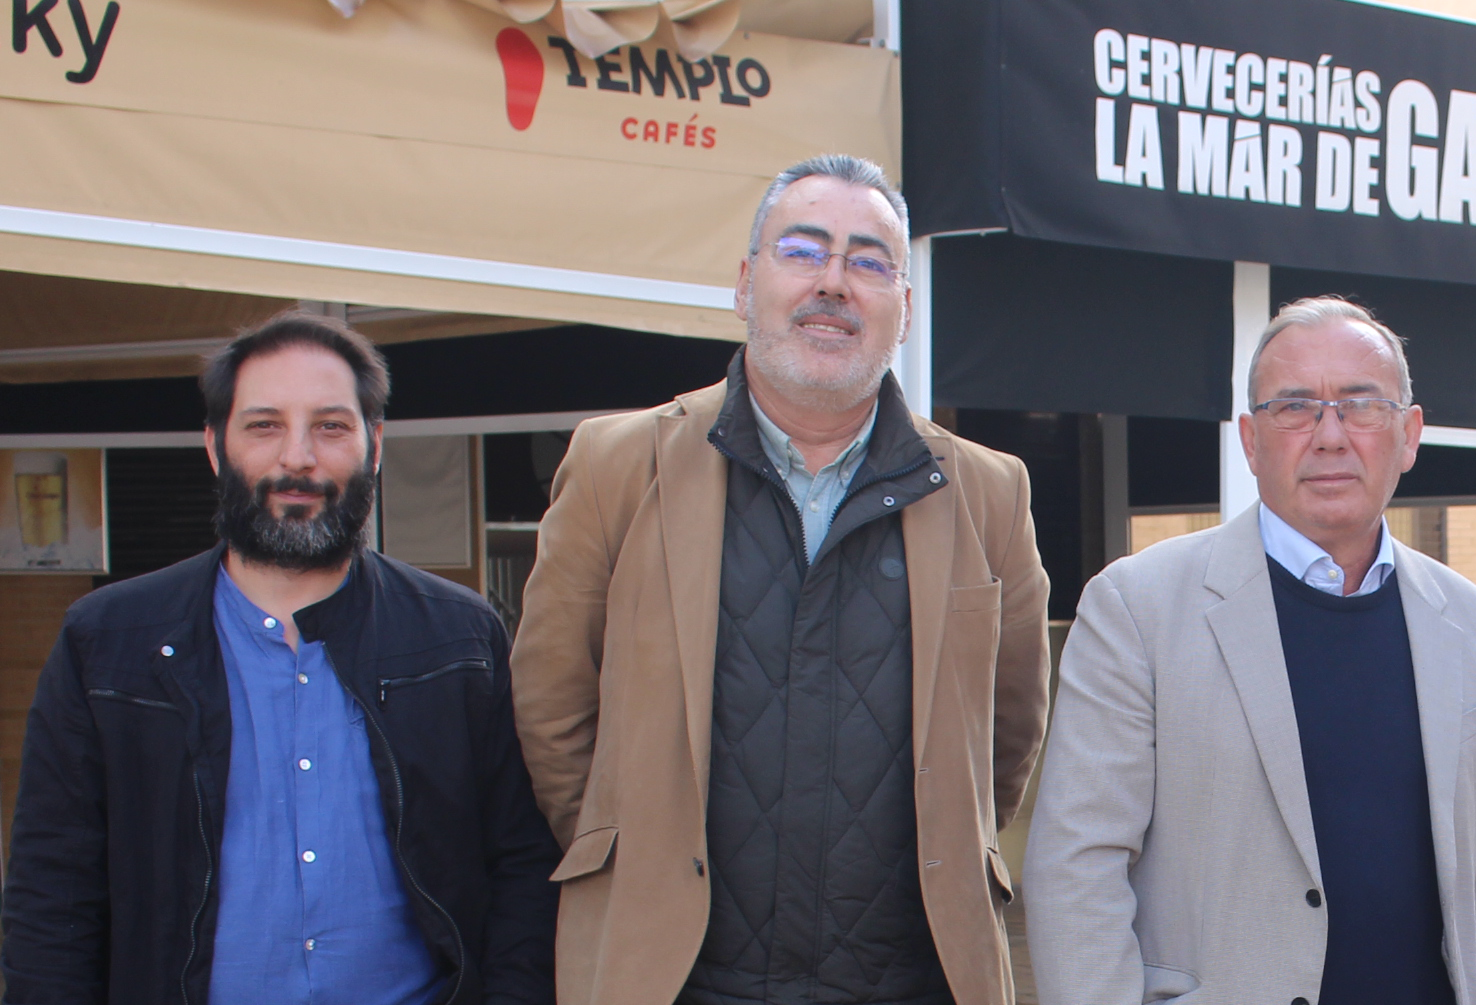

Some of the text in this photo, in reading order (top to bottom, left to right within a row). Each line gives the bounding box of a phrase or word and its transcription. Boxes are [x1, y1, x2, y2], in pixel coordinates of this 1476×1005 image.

[547, 35, 771, 107] TEMPLO
[621, 114, 717, 149] CAFÉS
[1095, 97, 1165, 190] LA
[1315, 131, 1381, 217] DE
